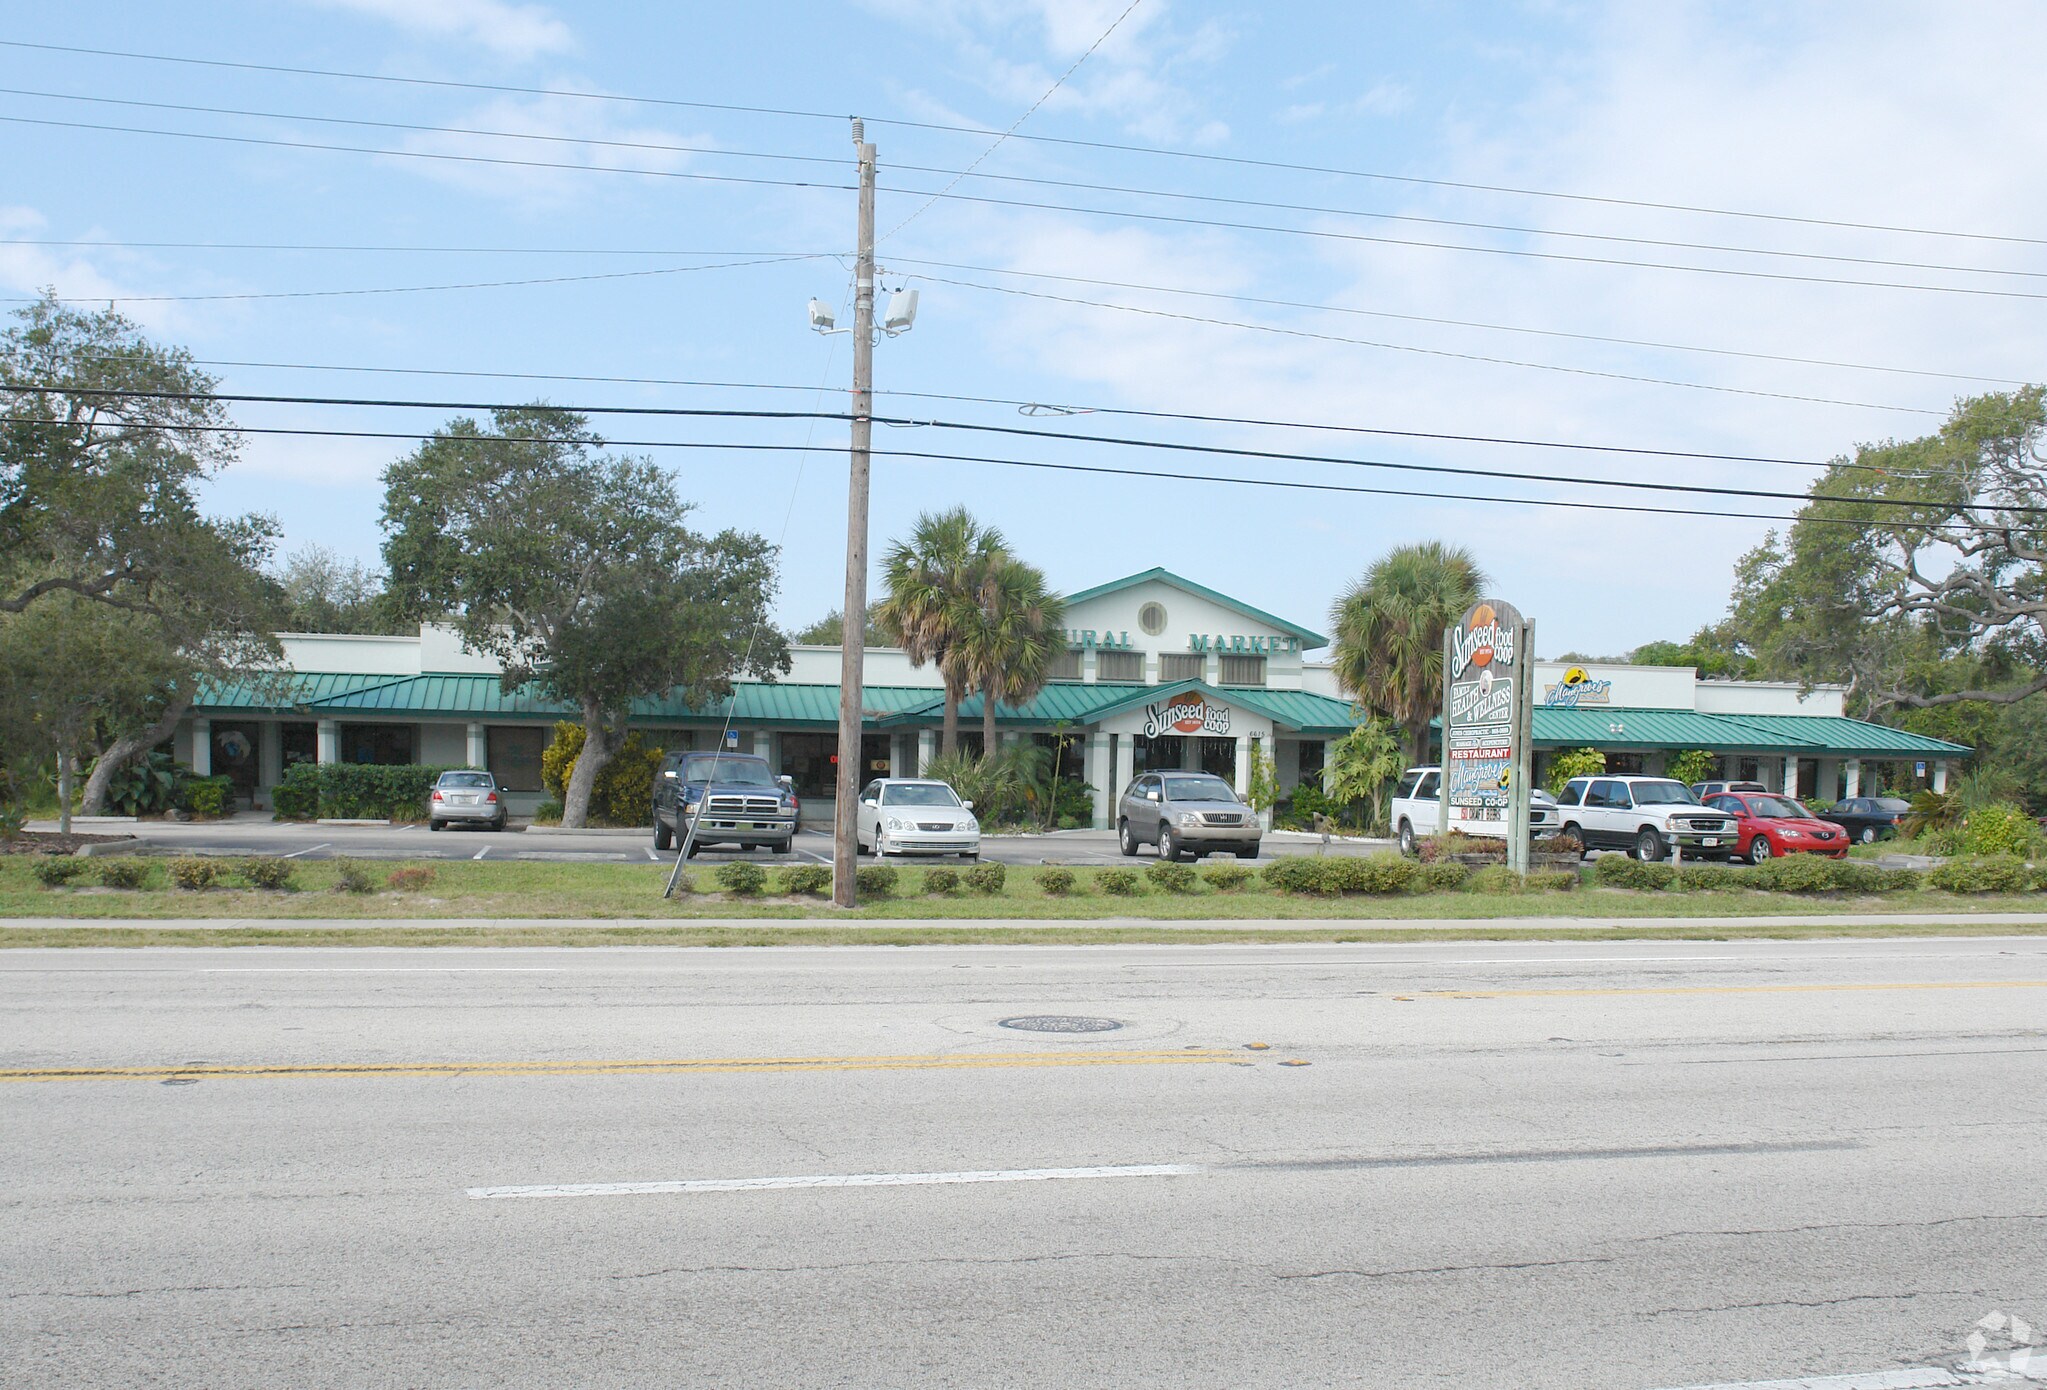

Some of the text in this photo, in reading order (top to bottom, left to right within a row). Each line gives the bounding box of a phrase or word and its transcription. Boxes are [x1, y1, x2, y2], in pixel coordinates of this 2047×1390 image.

[1058, 629, 1299, 656] URAL MARKET
[1452, 619, 1495, 678] Sunseed
[1495, 626, 1514, 647] food
[1452, 685, 1479, 717] HEALTH
[1473, 686, 1511, 723] WELLNESS
[1546, 680, 1611, 708] Mangroves
[1144, 701, 1205, 739] Sunseed
[1205, 706, 1230, 722] food
[1488, 707, 1509, 720] CENTER
[1452, 748, 1510, 759] RESTAURANT
[1450, 761, 1510, 793] Mangroves
[1450, 796, 1483, 806] SUNSEED
